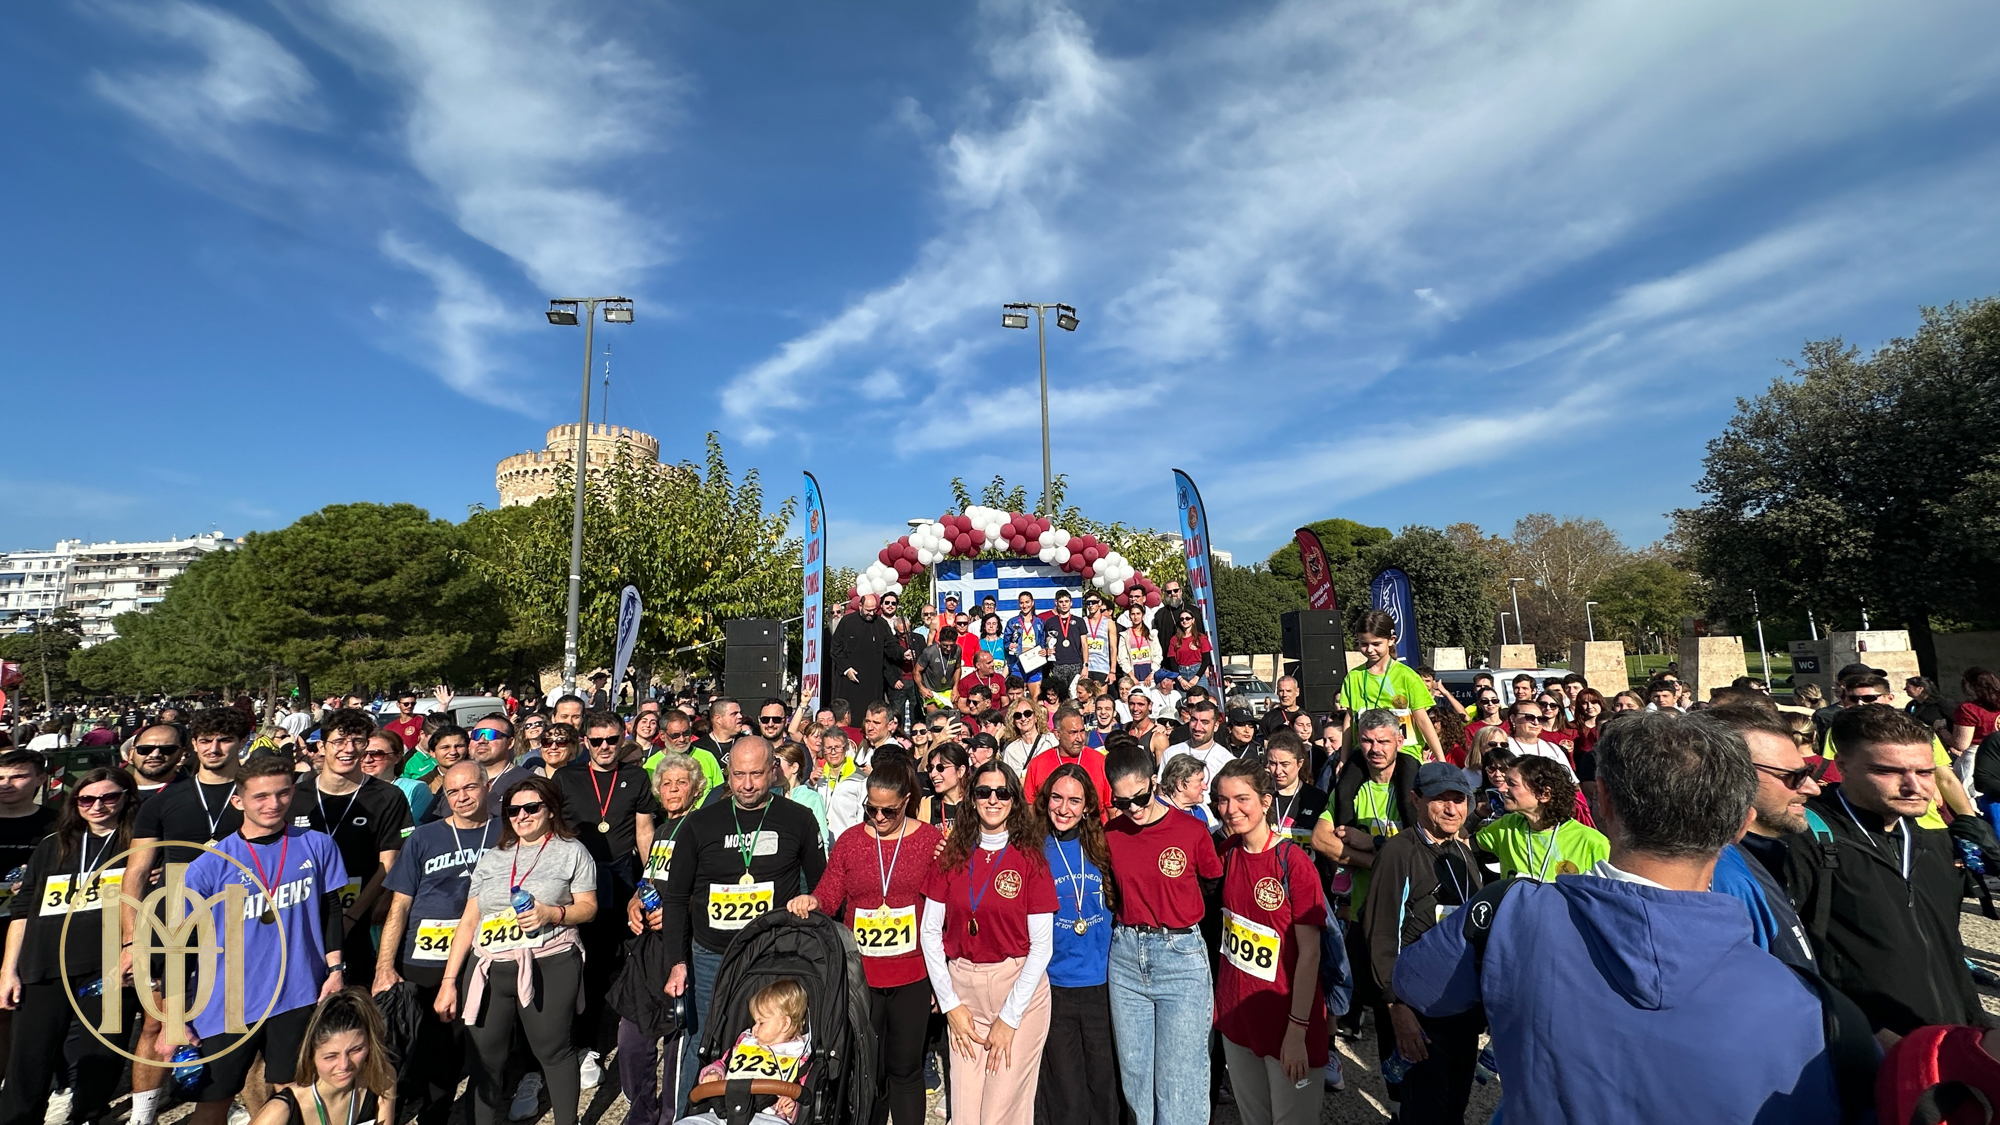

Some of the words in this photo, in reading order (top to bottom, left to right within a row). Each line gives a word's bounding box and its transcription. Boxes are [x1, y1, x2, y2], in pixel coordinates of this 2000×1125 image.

[1798, 661, 1815, 669] WC
[711, 900, 769, 921] 3229
[420, 935, 454, 952] 34
[856, 924, 911, 947] 3221
[1224, 926, 1273, 969] 3098
[729, 1053, 789, 1077] 323
